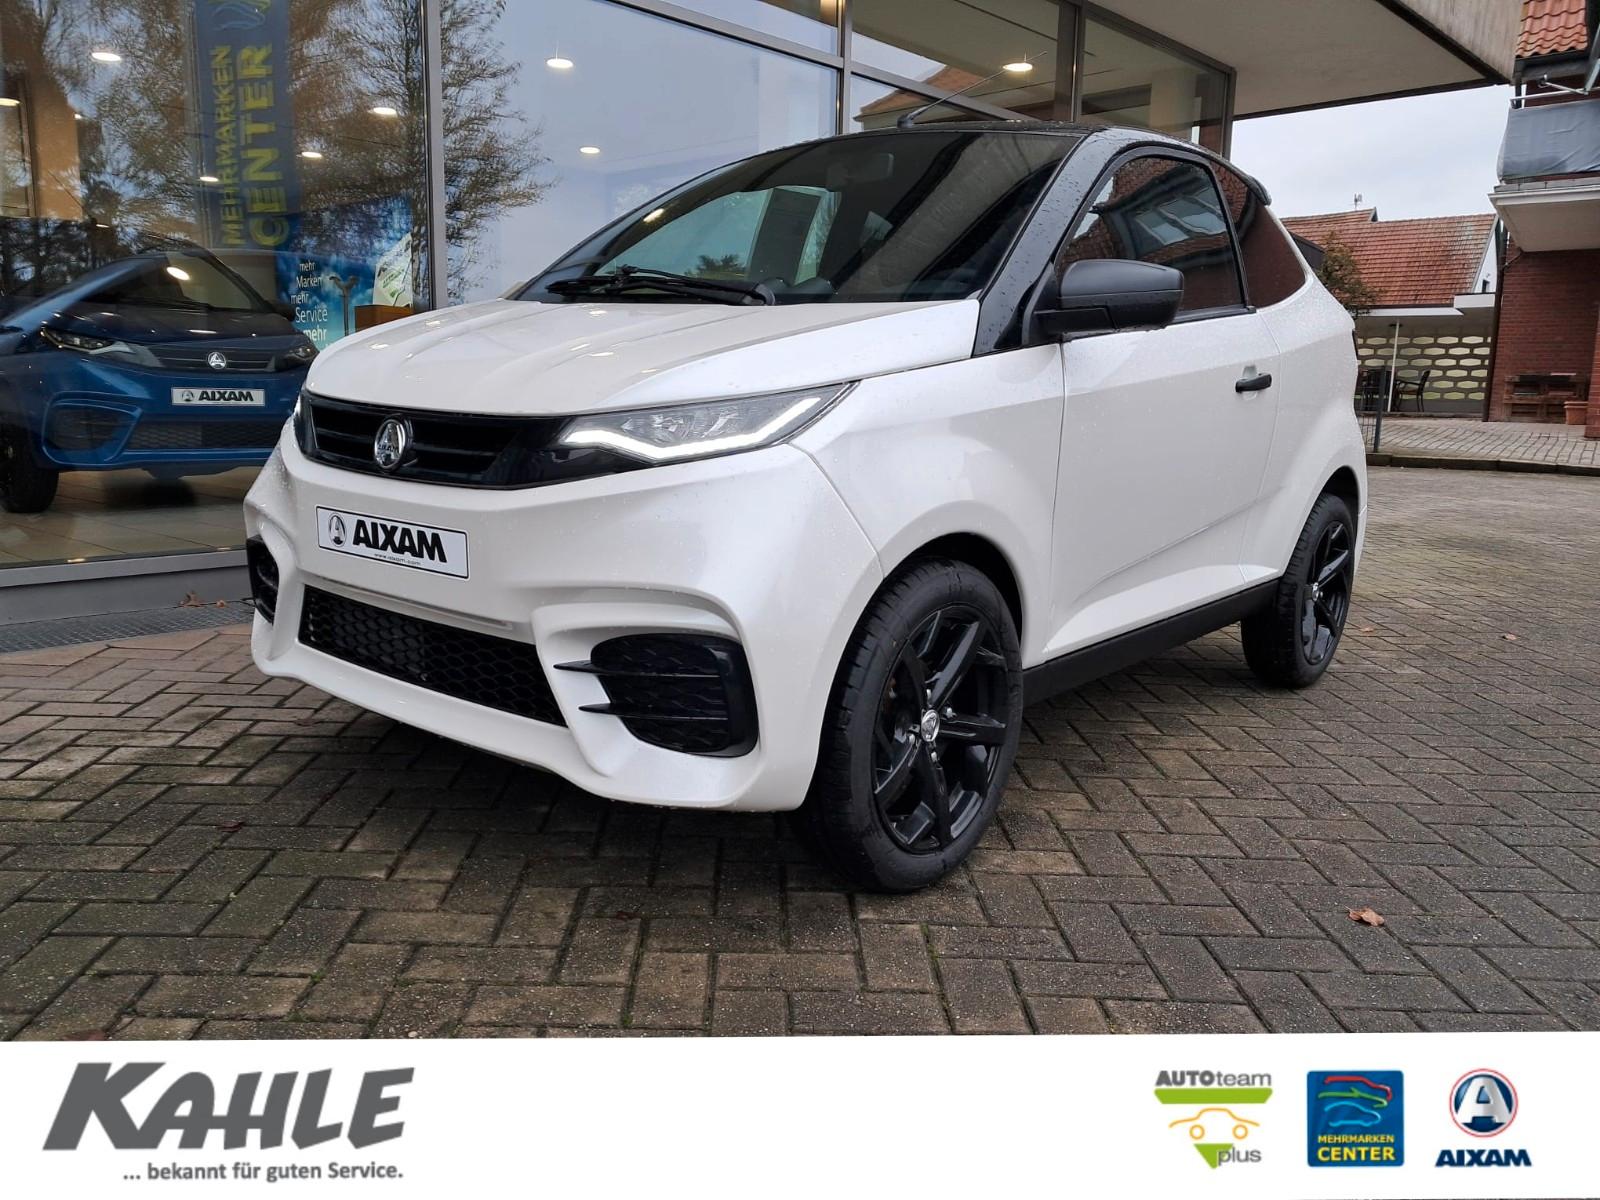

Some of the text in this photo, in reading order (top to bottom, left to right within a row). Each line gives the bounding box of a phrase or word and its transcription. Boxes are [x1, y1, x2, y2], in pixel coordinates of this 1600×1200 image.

[211, 45, 246, 246] MEHRMARKEN
[238, 43, 290, 247] CENTER
[299, 261, 316, 272] mehr
[290, 292, 309, 305] mehr
[295, 306, 328, 323] Service
[198, 390, 254, 402] AIXAM
[352, 519, 447, 563] AIXAM
